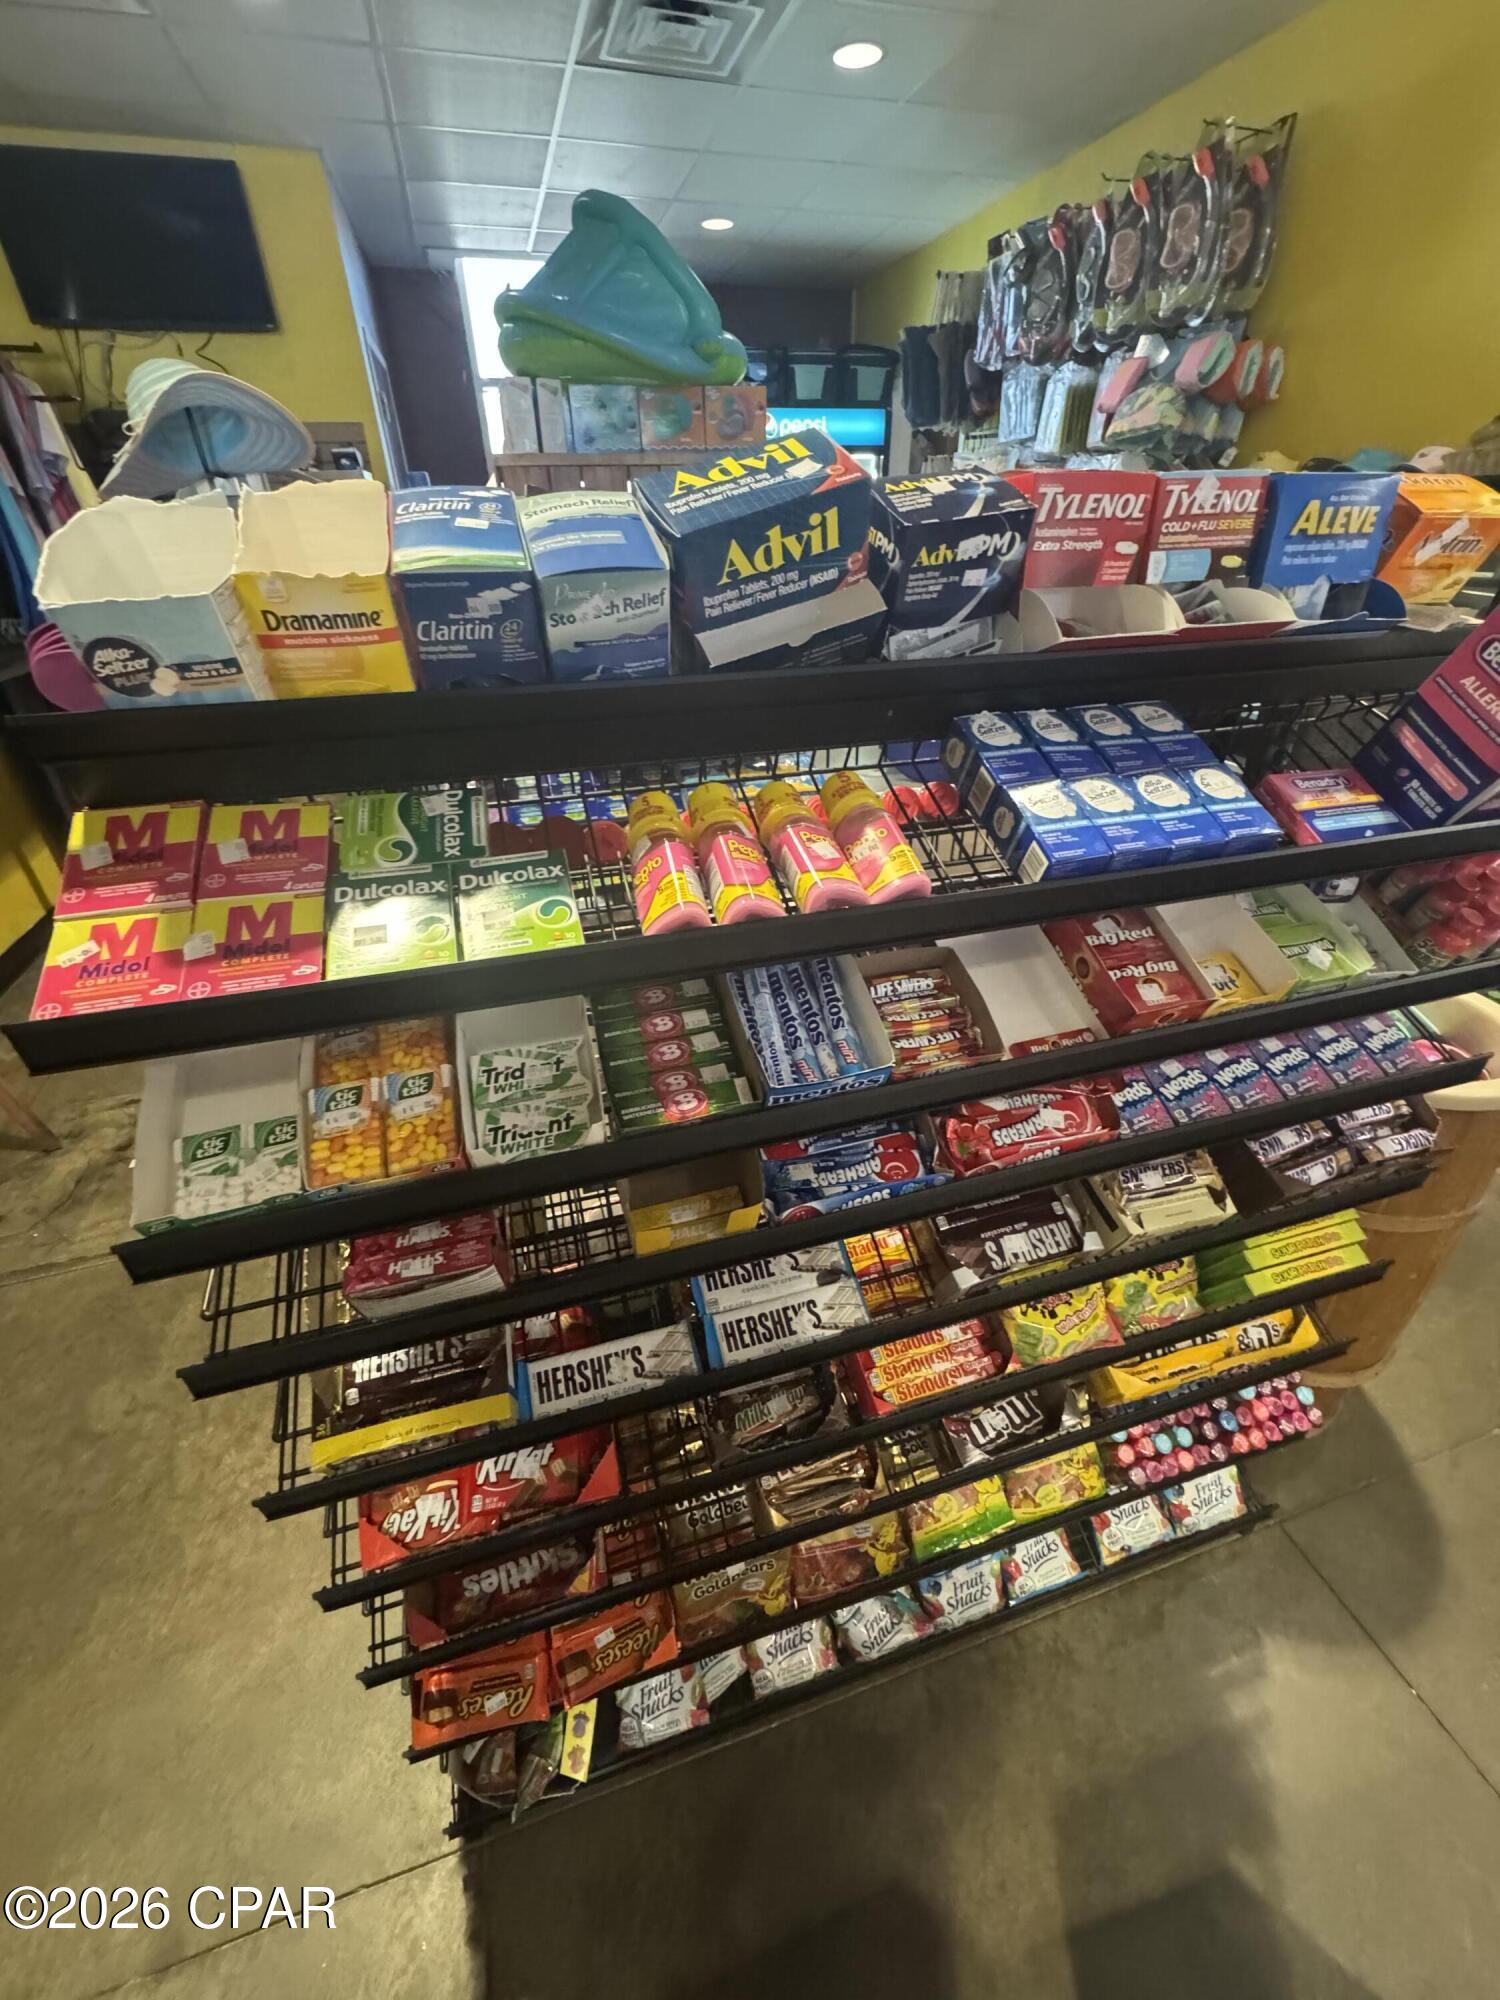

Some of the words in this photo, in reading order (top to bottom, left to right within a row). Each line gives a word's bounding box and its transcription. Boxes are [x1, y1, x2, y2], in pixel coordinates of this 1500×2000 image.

[669, 438, 813, 497] Advil
[396, 501, 471, 515] Claritin
[524, 499, 588, 519] Stomach
[592, 497, 635, 510] Relief
[1036, 487, 1146, 523] TYLENOL
[1162, 521, 1190, 533] COLD
[1290, 500, 1381, 537] ALEVE
[717, 506, 840, 585] Advil
[1033, 541, 1060, 551] Extra
[623, 587, 667, 614] Relief
[261, 610, 382, 631] Dramamine
[416, 621, 494, 642] Claritin
[94, 657, 150, 677] Seltzer
[1294, 776, 1350, 790] Benadryl
[443, 790, 465, 857] Dulcolax
[460, 865, 565, 890] Dulcolax
[335, 879, 447, 903] Dulcolax
[1085, 931, 1118, 947] Big
[1119, 926, 1155, 941] Red
[221, 953, 290, 967] COMPLETE
[223, 942, 290, 958] Midol
[79, 960, 149, 980] Midol
[1107, 965, 1147, 981] Red
[1145, 960, 1179, 973] Big
[75, 972, 149, 988] COMPLETE
[870, 982, 894, 998] LIFE
[894, 978, 935, 995] SAVERS
[815, 958, 846, 1031] mentos
[767, 972, 803, 1051] mentos
[788, 967, 825, 1046] mentos
[837, 1039, 858, 1064] mint
[1030, 1043, 1050, 1053] Big
[1062, 1034, 1083, 1047] Red
[406, 1075, 428, 1088] tic
[793, 1060, 819, 1083] mint
[335, 1087, 358, 1101] tic
[401, 1083, 429, 1097] tac
[328, 1095, 358, 1111] tac
[267, 1130, 296, 1145] tac
[274, 1121, 296, 1135] tic
[195, 1145, 225, 1160] tac
[202, 1136, 225, 1150] tic
[500, 1136, 555, 1155] WHITE
[811, 1157, 882, 1188] AIRHEADS
[1191, 1485, 1233, 1514] Snacks
[1022, 1537, 1060, 1574] Snacks
[463, 1538, 579, 1598] Skittles
[952, 1571, 986, 1598] Fruit
[946, 1583, 993, 1615] Snacks
[864, 1605, 891, 1638] Fruit
[861, 1615, 901, 1653] Snacks
[766, 1628, 815, 1666] Snacks
[639, 1670, 676, 1705] Fruit
[630, 1684, 686, 1723] Snacks
